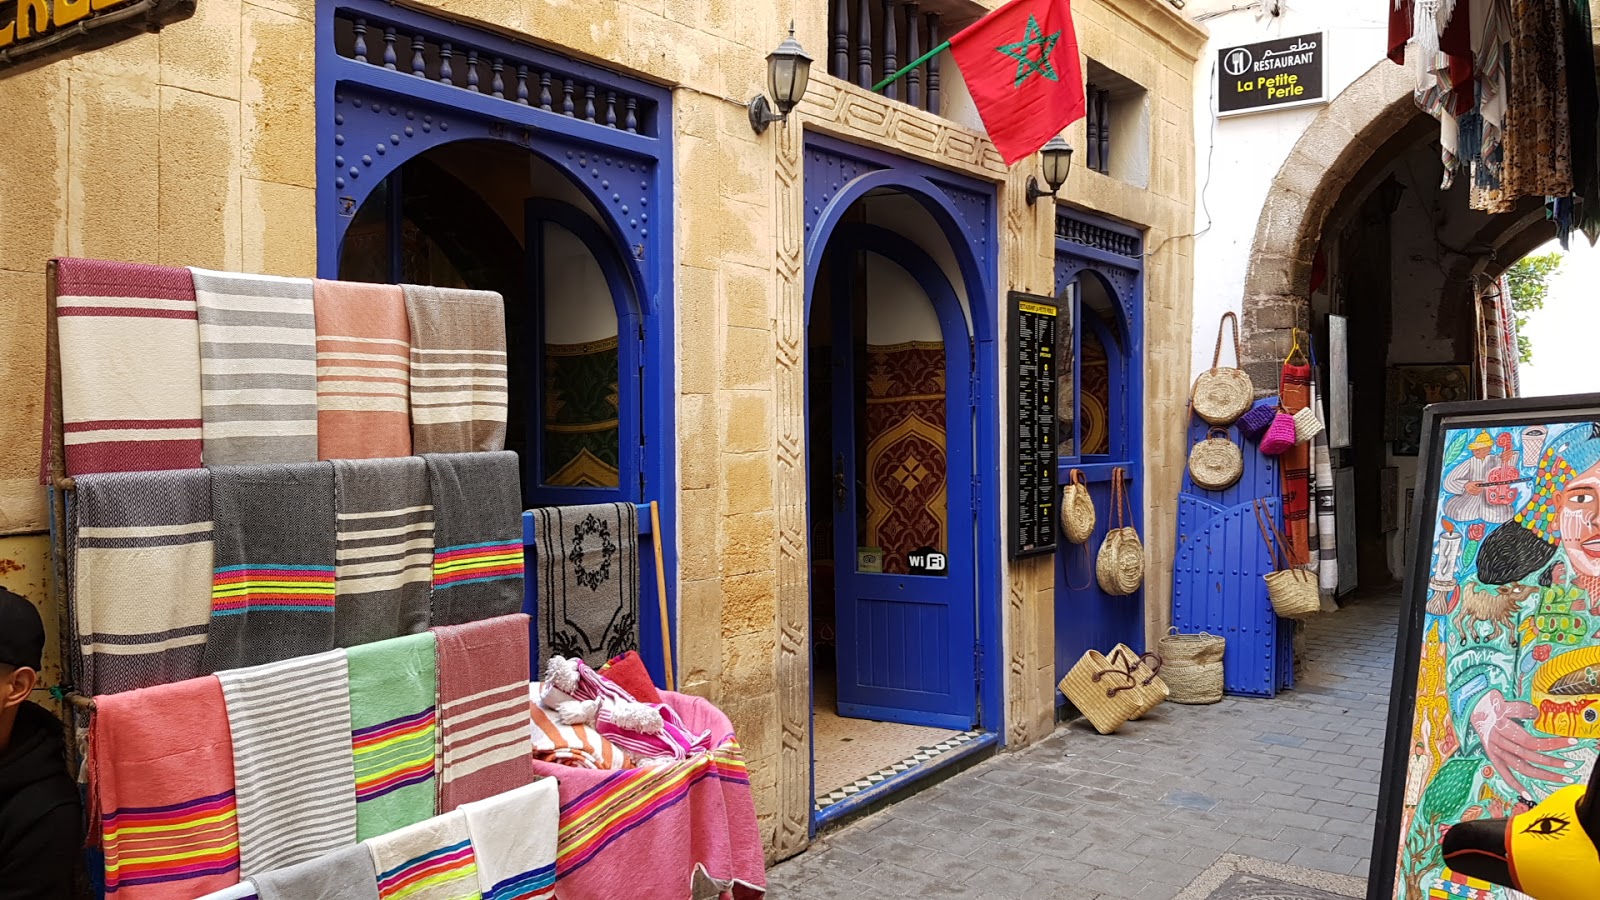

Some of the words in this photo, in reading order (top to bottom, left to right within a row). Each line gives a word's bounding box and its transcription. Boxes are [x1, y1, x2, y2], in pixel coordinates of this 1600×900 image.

[1263, 38, 1317, 60] مطعم
[1254, 53, 1314, 72] RESTAURANT
[1237, 81, 1253, 92] La
[1257, 73, 1298, 89] Petite
[1267, 84, 1304, 99] Perle
